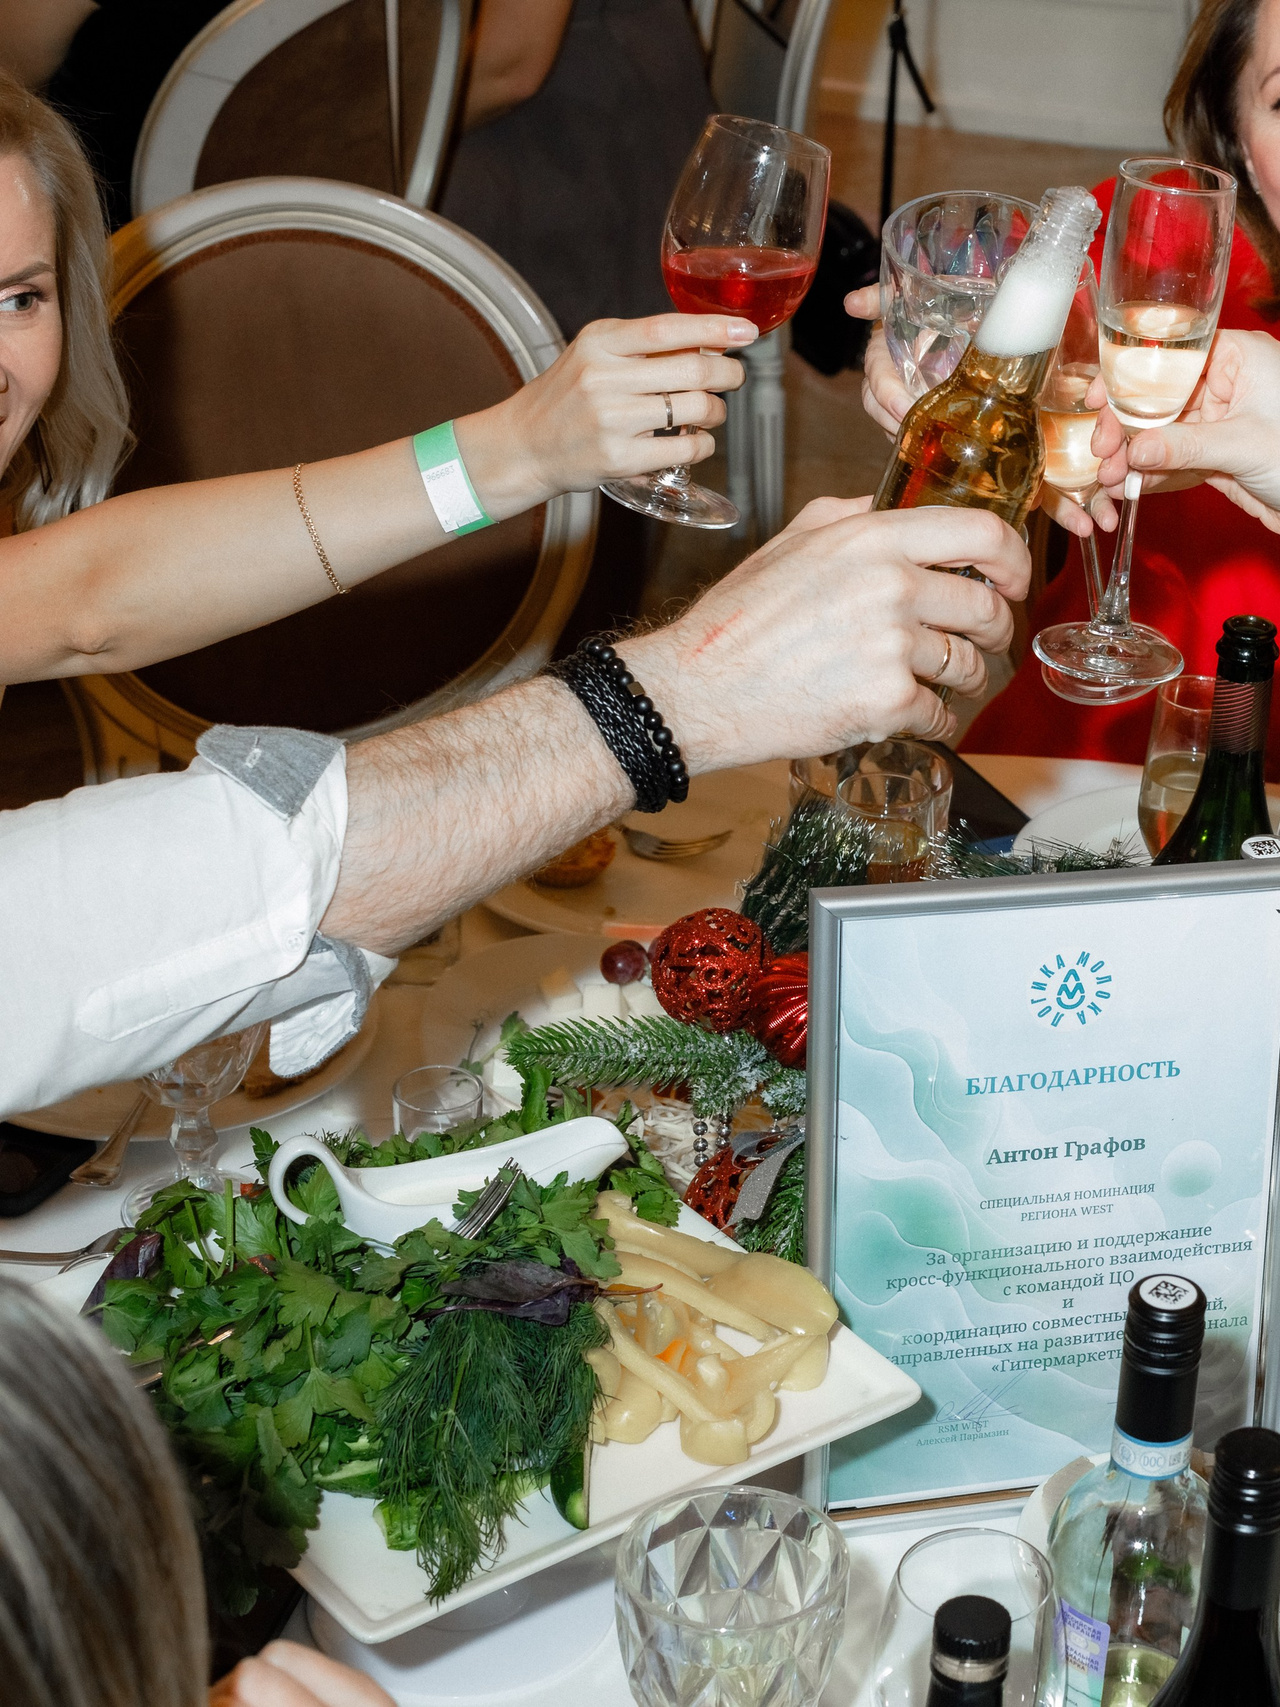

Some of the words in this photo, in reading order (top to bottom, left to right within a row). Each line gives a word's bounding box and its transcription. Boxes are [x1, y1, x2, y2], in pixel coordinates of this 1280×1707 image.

[1031, 954, 1065, 1027] ЛОГИКА
[1076, 951, 1112, 1025] МОЛОКА
[965, 1060, 1181, 1096] БЛАГОДАРНОСТЬ
[986, 1145, 1059, 1165] Антон
[1063, 1137, 1146, 1161] Графов
[980, 1191, 1071, 1210] СПЕЦИАЛЬНАЯ
[1074, 1183, 1156, 1201] НОМИНАЦИЯ
[1020, 1207, 1077, 1222] РЕГИОНА
[1080, 1203, 1114, 1216] WEST
[926, 1252, 946, 1266] За
[952, 1240, 1073, 1266] организацию
[1077, 1239, 1089, 1250] и
[1094, 1225, 1213, 1249] поддержание
[886, 1256, 1105, 1292] кросс-функционального
[1109, 1239, 1253, 1265] взаимодействия
[1003, 1285, 1011, 1296] с
[1016, 1273, 1105, 1295] командой
[1109, 1269, 1135, 1286] ЦО
[1062, 1297, 1075, 1309] и
[886, 1342, 1013, 1368] аправленных
[1017, 1339, 1038, 1351] на
[1044, 1329, 1124, 1350] развитие
[1204, 1314, 1248, 1330] нала
[901, 1321, 1027, 1346] координацию
[1032, 1310, 1128, 1331] совместны
[916, 1433, 957, 1446] Алексей
[938, 1423, 959, 1433] RSM
[962, 1420, 989, 1431] WEST
[1142, 1455, 1163, 1468] DOC
